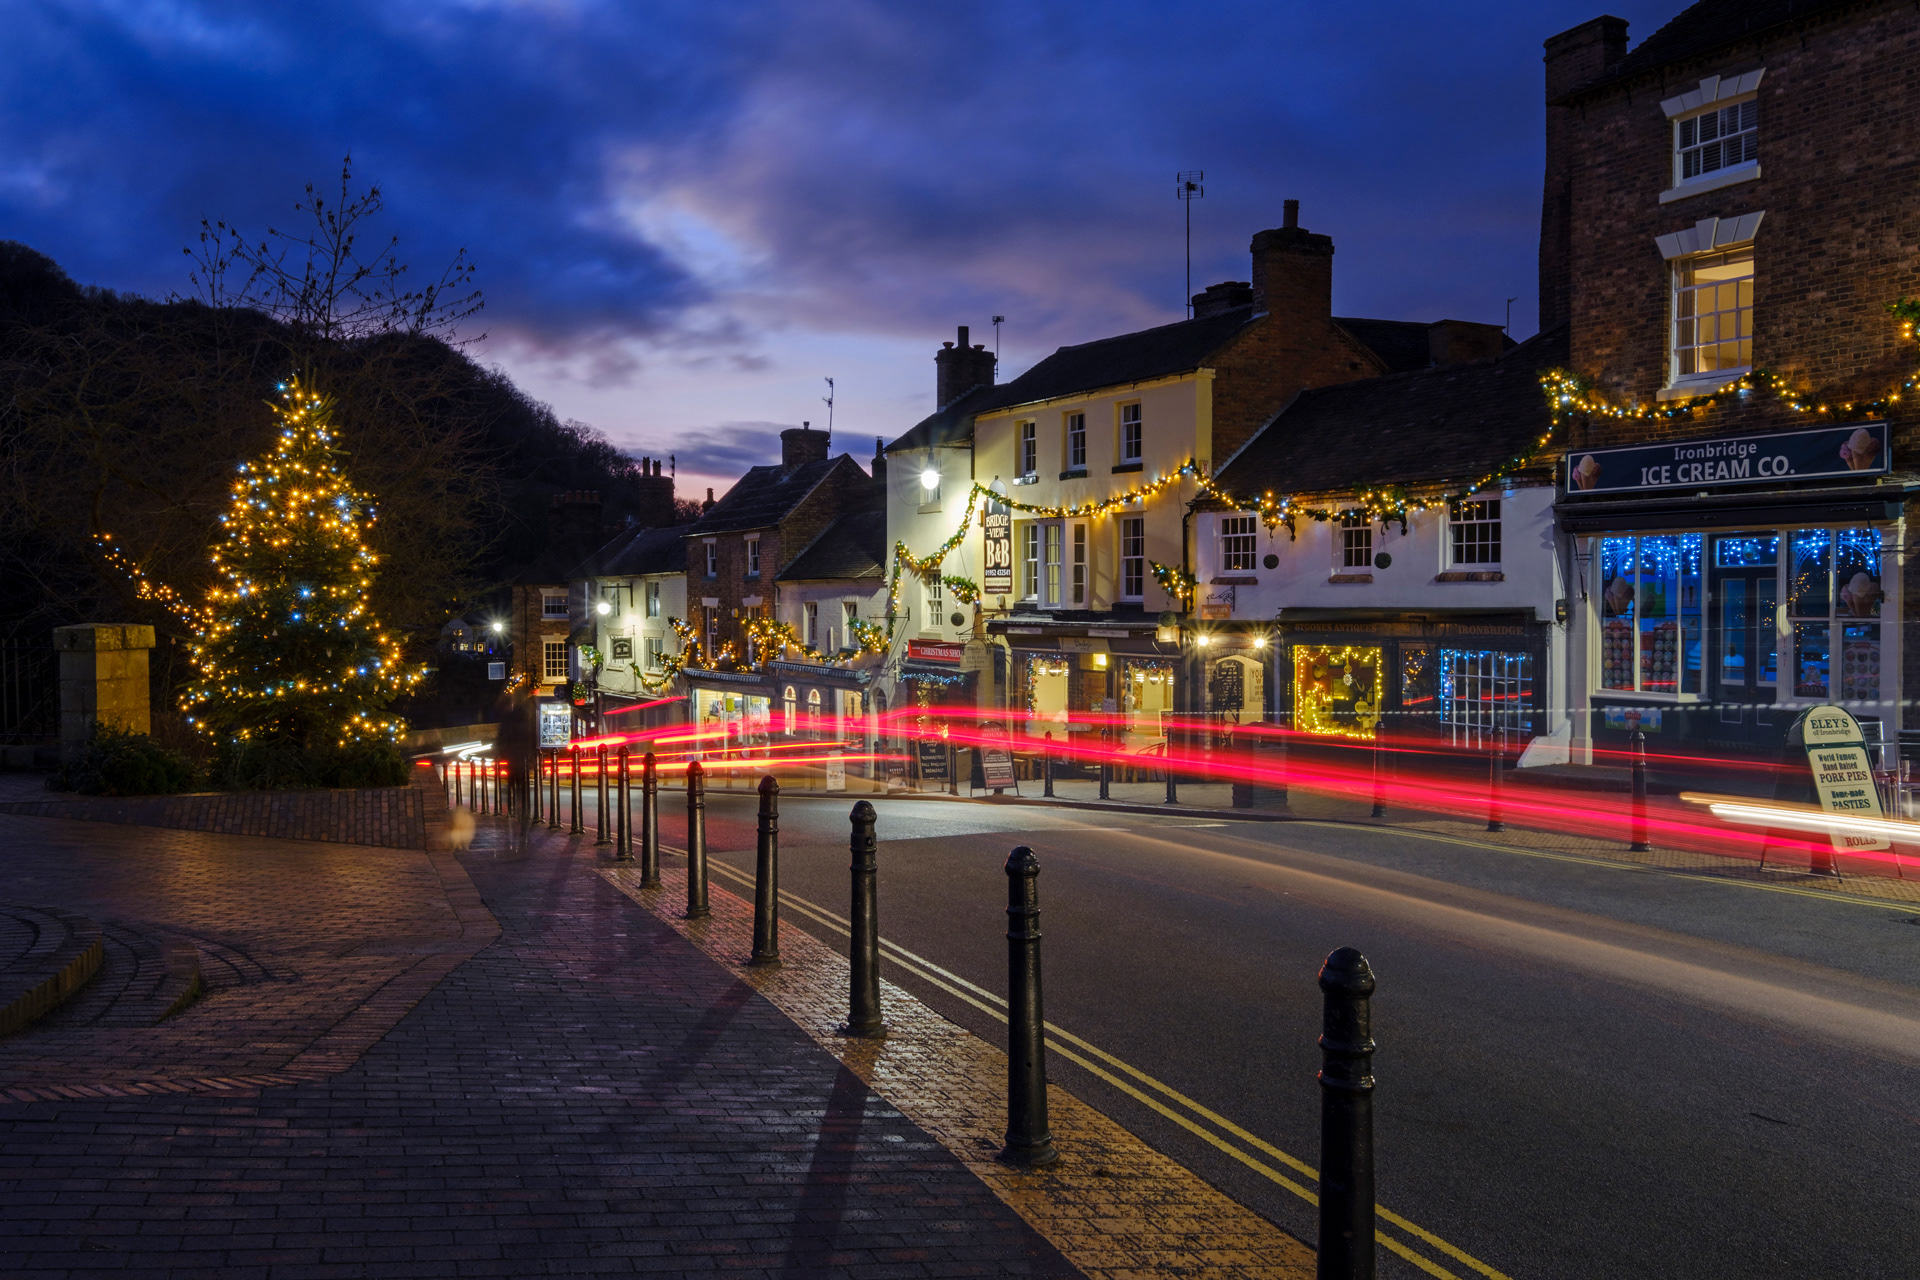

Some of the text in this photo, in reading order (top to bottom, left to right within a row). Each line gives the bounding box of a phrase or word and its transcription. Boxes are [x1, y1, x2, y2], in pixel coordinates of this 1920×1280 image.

[1674, 442, 1757, 460] Ironbridge
[1641, 455, 1795, 485] ICE CREAM CO.
[986, 515, 1009, 527] BRIDGE
[989, 528, 1004, 538] VIEW
[986, 539, 1009, 568] B&B
[1333, 623, 1377, 633] ANTIQUES
[1458, 625, 1524, 635] IRONBRIDGE
[920, 646, 949, 657] CHRISTMAS
[1810, 718, 1849, 729] ELEY'S
[1820, 728, 1851, 737] Ironbridge
[1817, 752, 1858, 762] World Famous
[1822, 762, 1858, 772] Hand Raised
[1819, 770, 1868, 783] PORK PIES
[1831, 789, 1865, 798] Home-made
[1832, 799, 1871, 810] PASTIES
[1845, 836, 1877, 847] ROLLS
